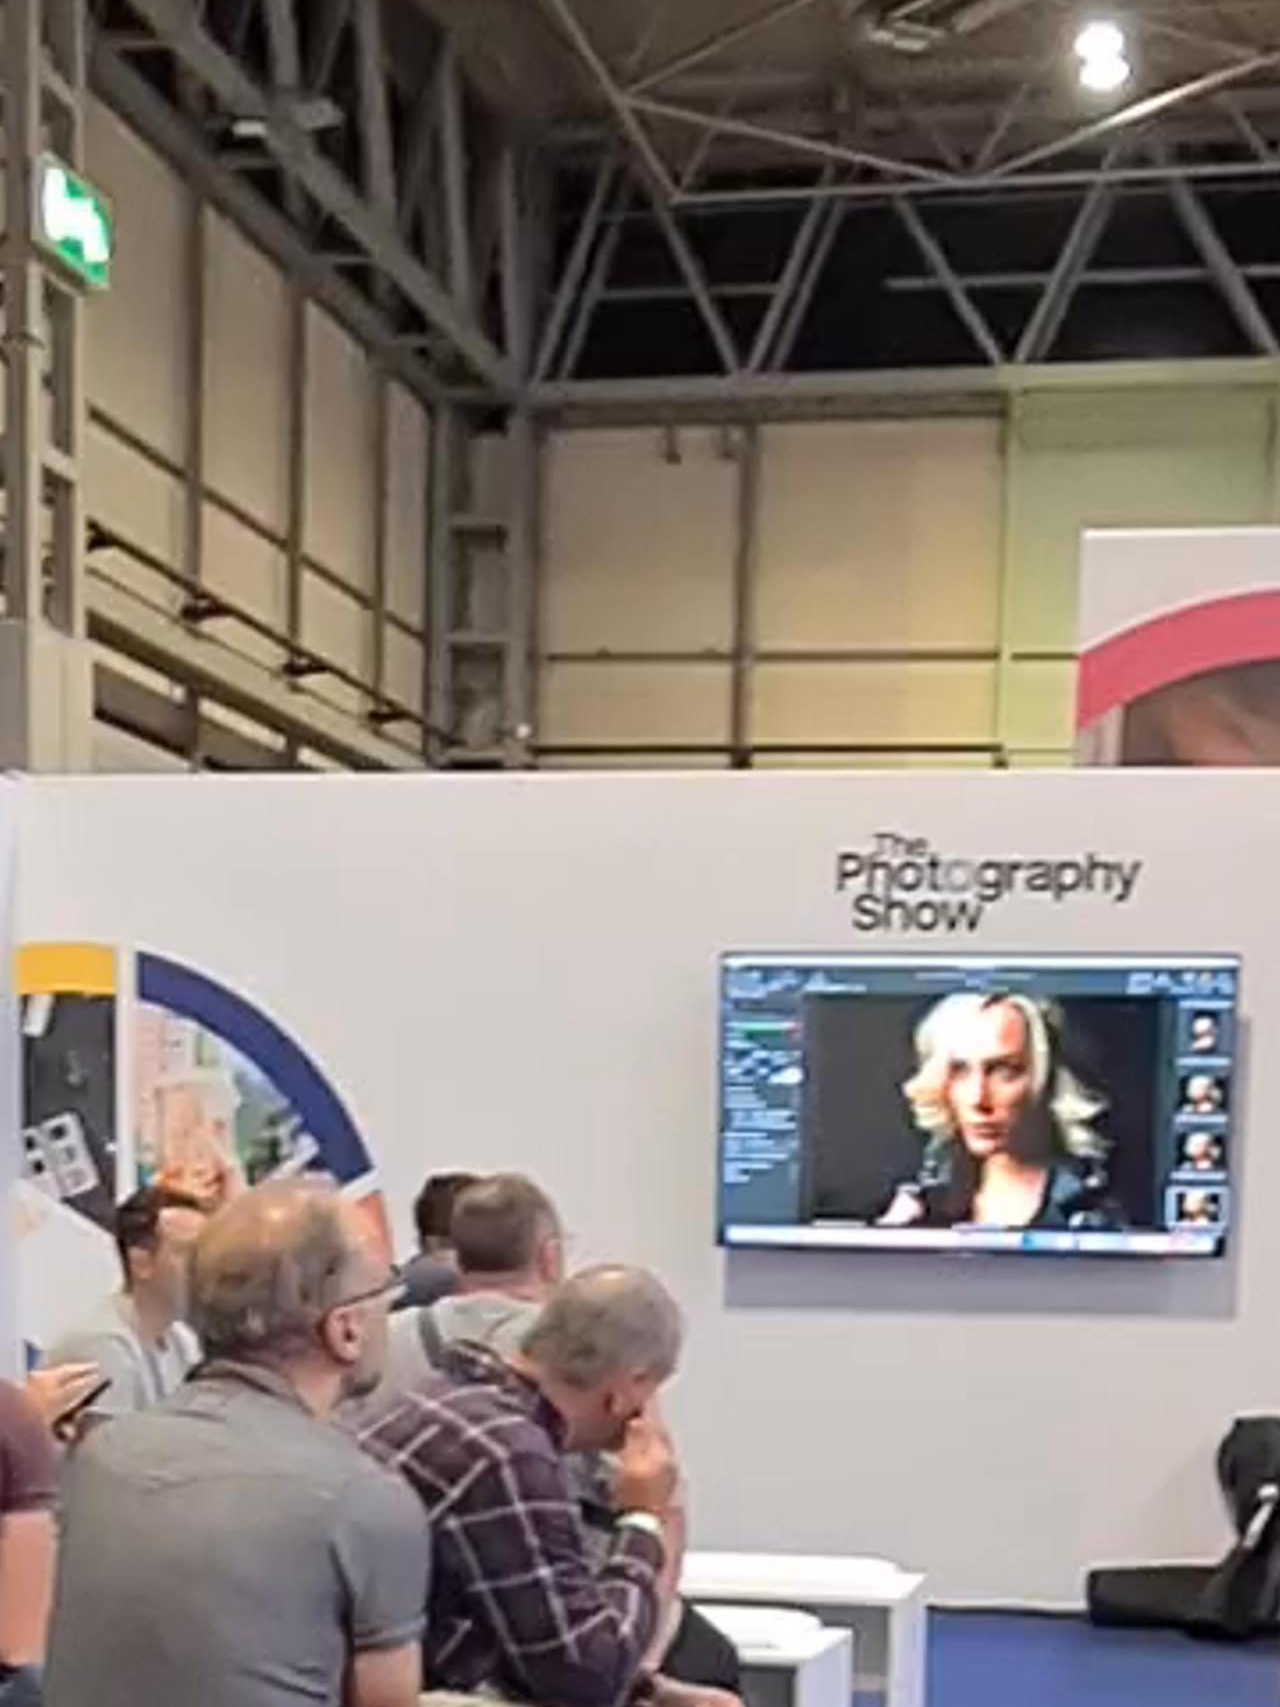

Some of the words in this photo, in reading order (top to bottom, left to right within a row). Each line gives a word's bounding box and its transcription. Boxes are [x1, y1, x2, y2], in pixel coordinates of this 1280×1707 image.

[873, 832, 929, 857] The
[836, 851, 1144, 903] Photography
[852, 893, 984, 932] Show
